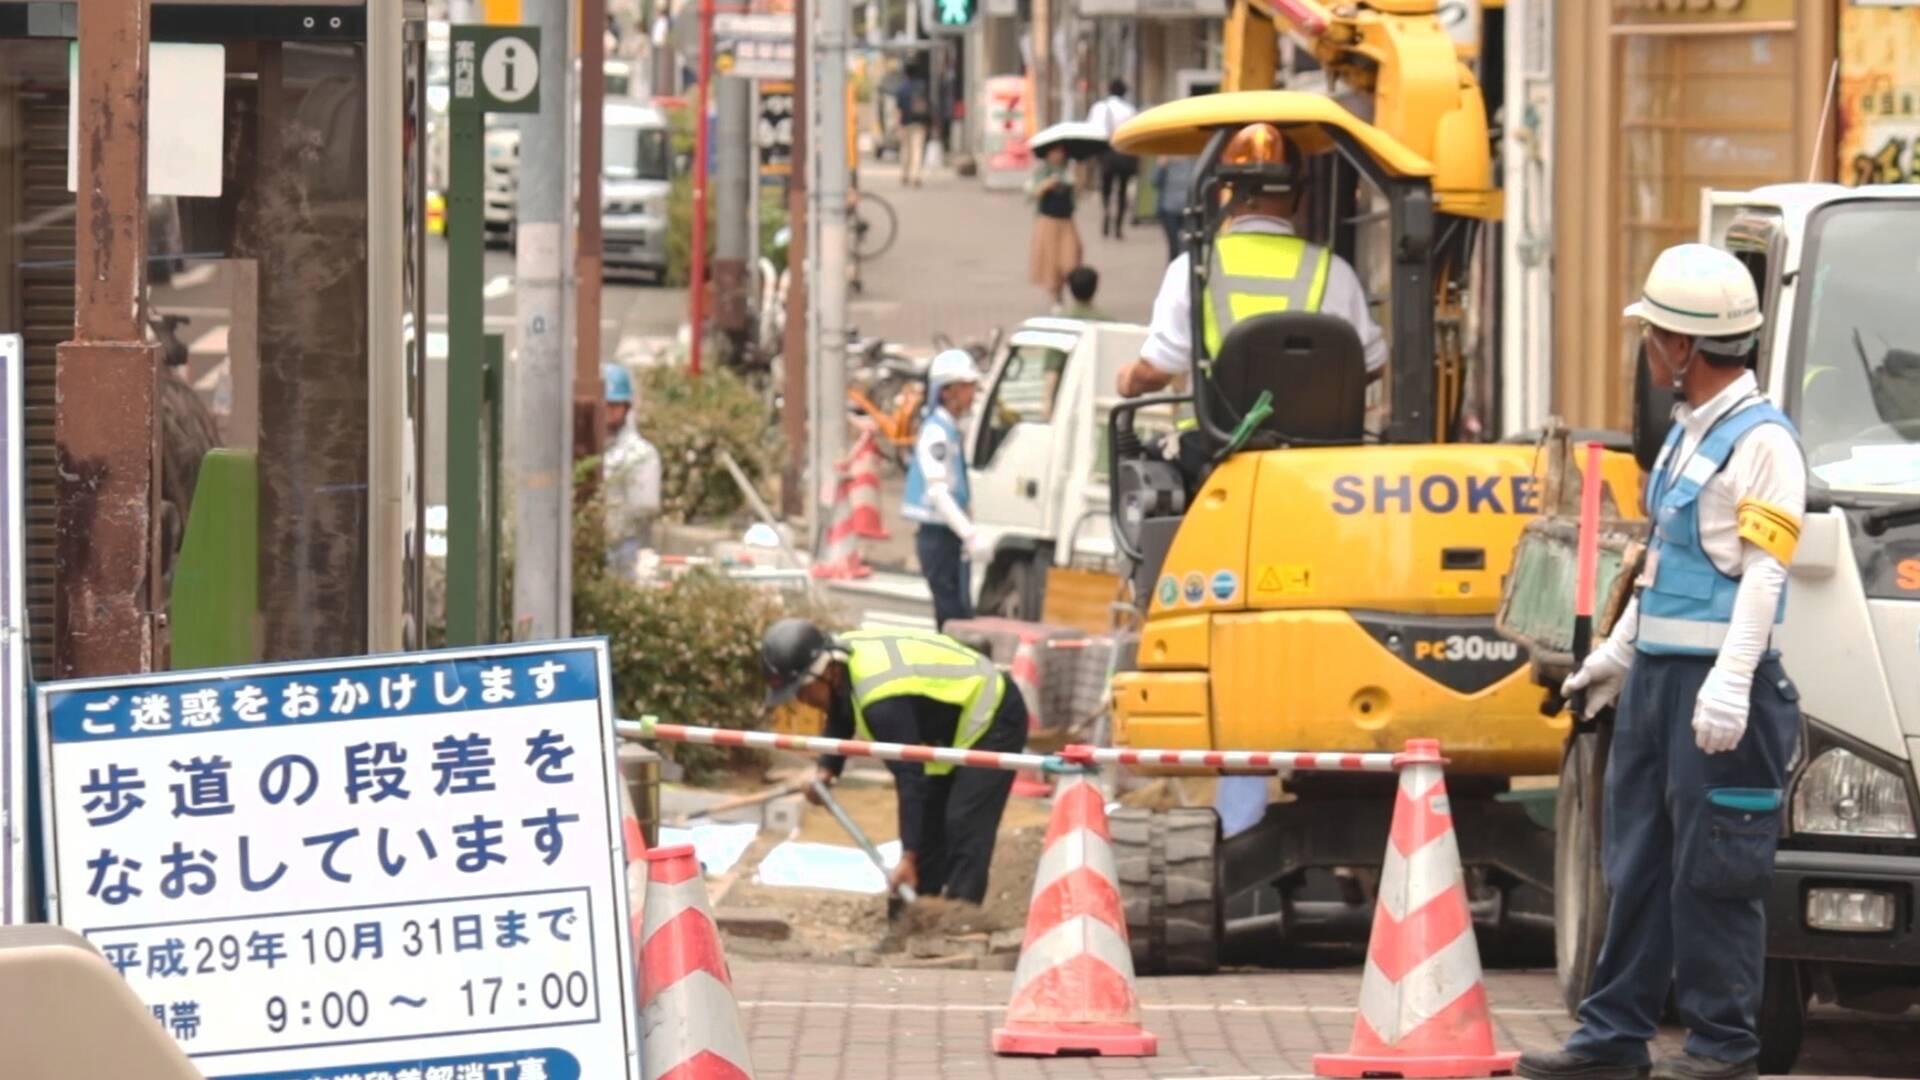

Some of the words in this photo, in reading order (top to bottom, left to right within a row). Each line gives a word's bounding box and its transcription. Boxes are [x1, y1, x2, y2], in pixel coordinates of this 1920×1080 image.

[81, 660, 566, 734] ご迷惑をおかけします
[80, 729, 575, 827] 歩道の段差を
[86, 807, 580, 905] なおしています
